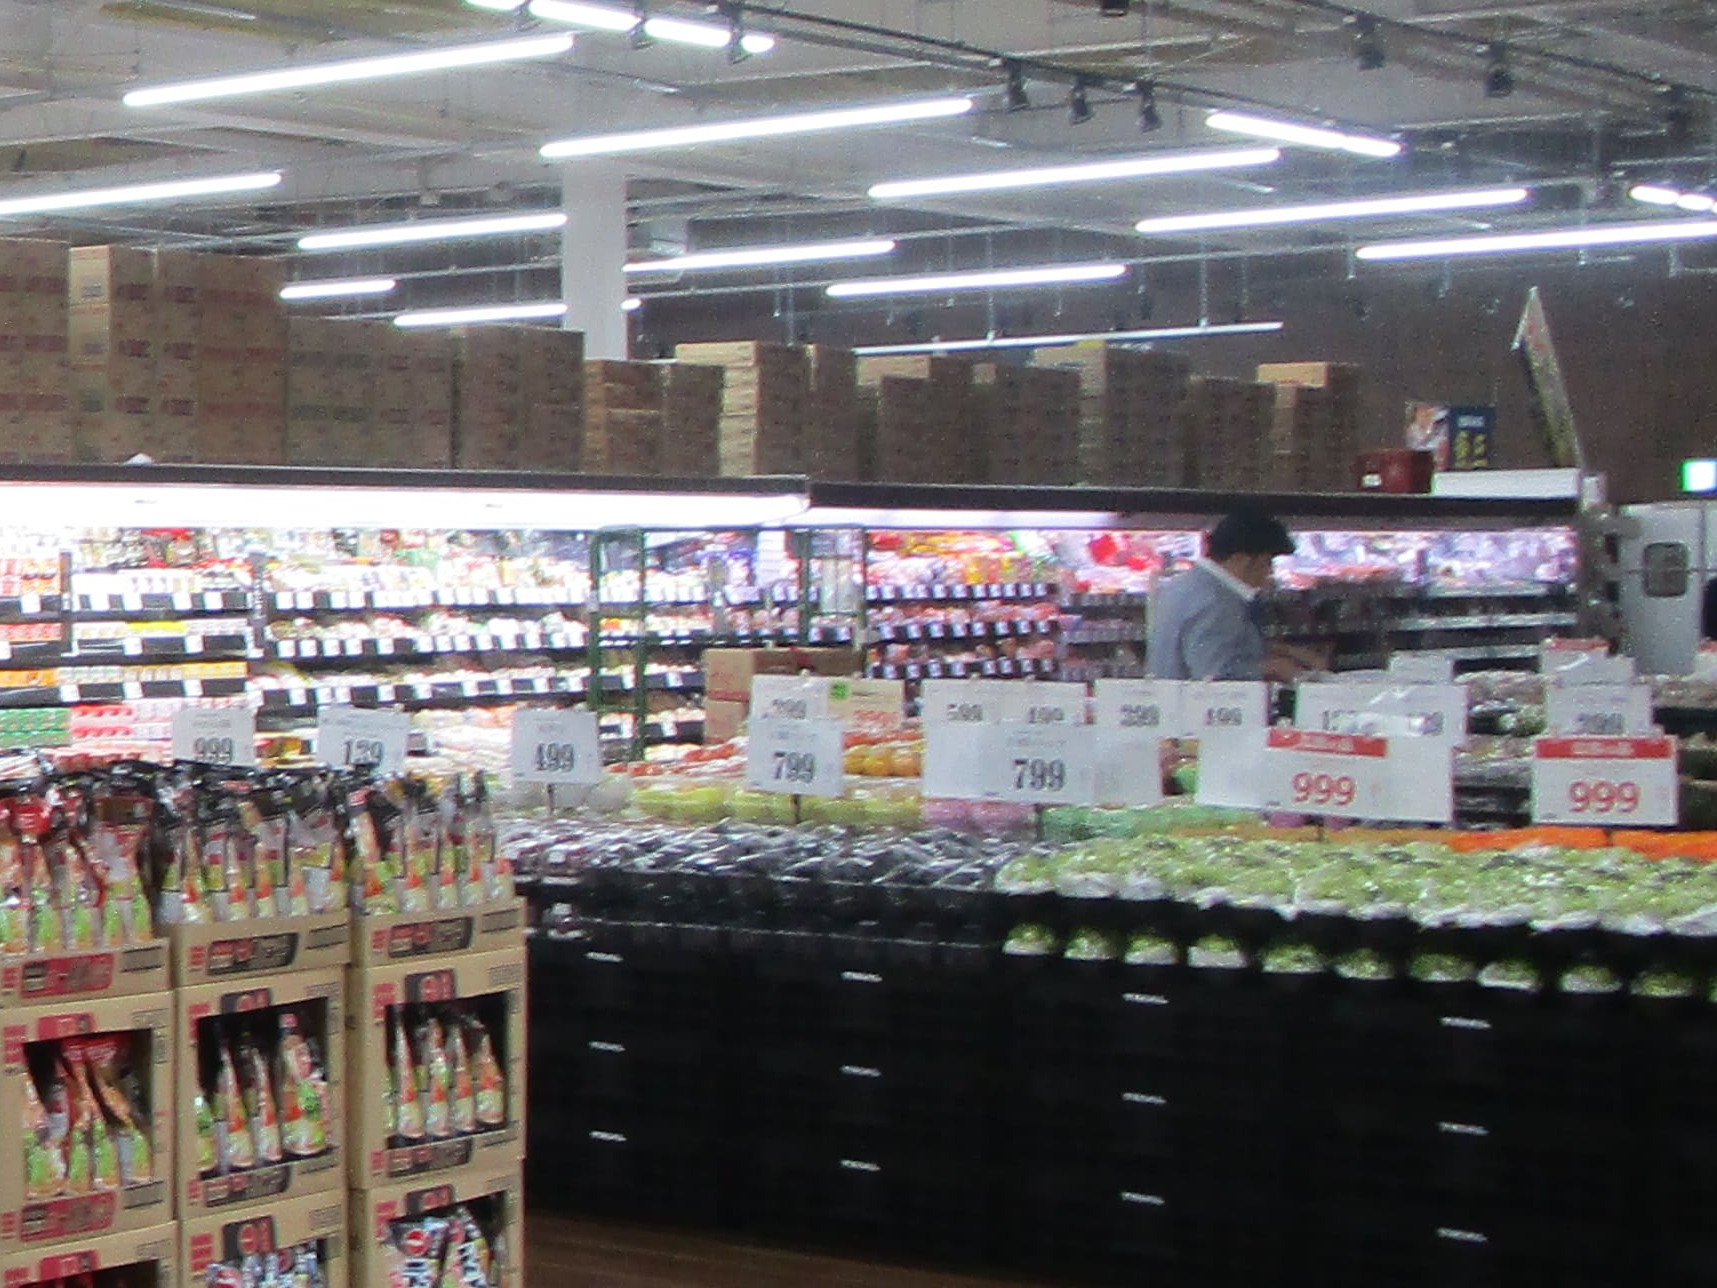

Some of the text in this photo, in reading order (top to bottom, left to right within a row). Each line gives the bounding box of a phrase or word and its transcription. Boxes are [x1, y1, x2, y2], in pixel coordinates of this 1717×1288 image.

[1014, 758, 1066, 792] 799
[1292, 772, 1357, 805] 999
[1569, 780, 1640, 813] 999
